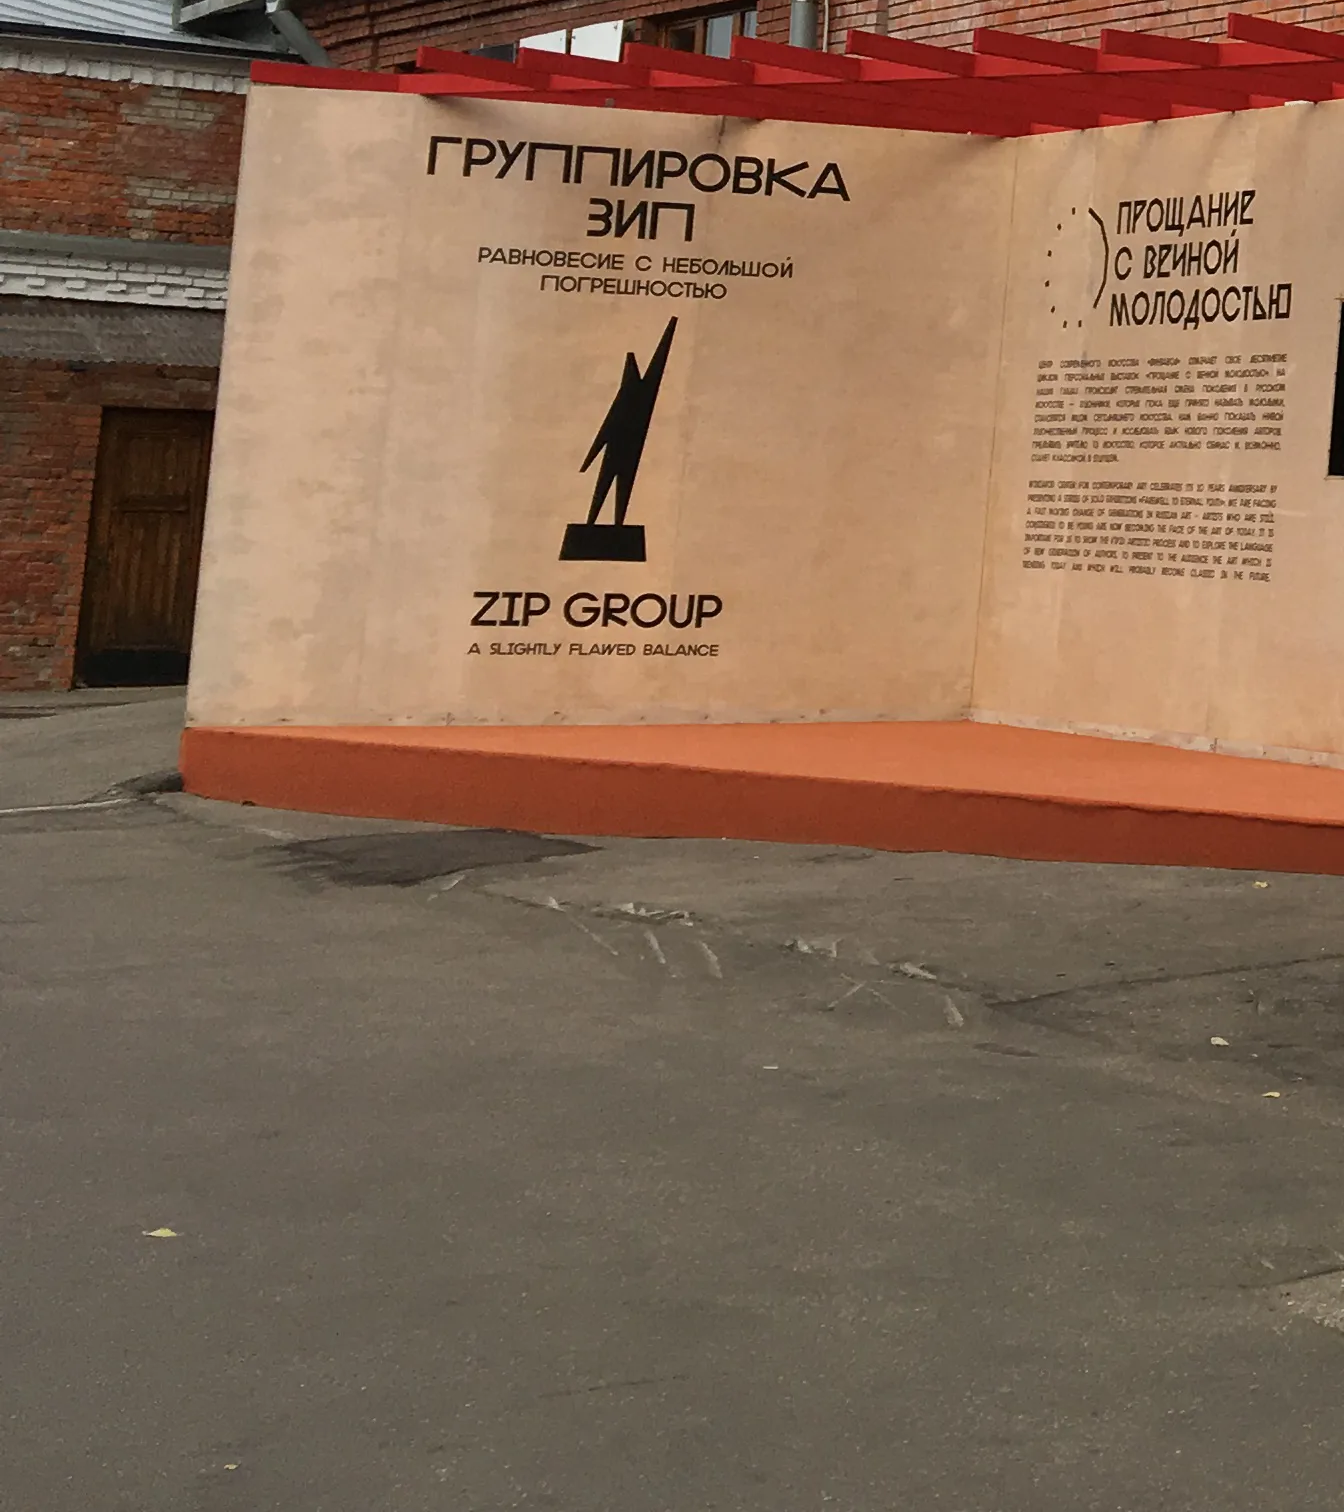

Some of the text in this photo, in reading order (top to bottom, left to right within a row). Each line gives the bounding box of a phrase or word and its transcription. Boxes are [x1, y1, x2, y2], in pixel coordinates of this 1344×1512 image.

[427, 135, 850, 201] ГРУППИРОВКА
[586, 198, 695, 242] ЗИП
[1117, 190, 1256, 237] ПРОЩАНИЕ
[478, 247, 793, 279] РАВНОВЕСИЕ С НЕБОЛЬШОЙ
[1115, 247, 1132, 280] С
[540, 275, 727, 299] ПОГРЕШНОСТЬЮ
[1110, 283, 1292, 330] МОЛОДОСТЬЮ
[470, 592, 723, 628] ZIP GROUP
[467, 643, 719, 656] A SLIGHTLY FLAWED BALANCE
